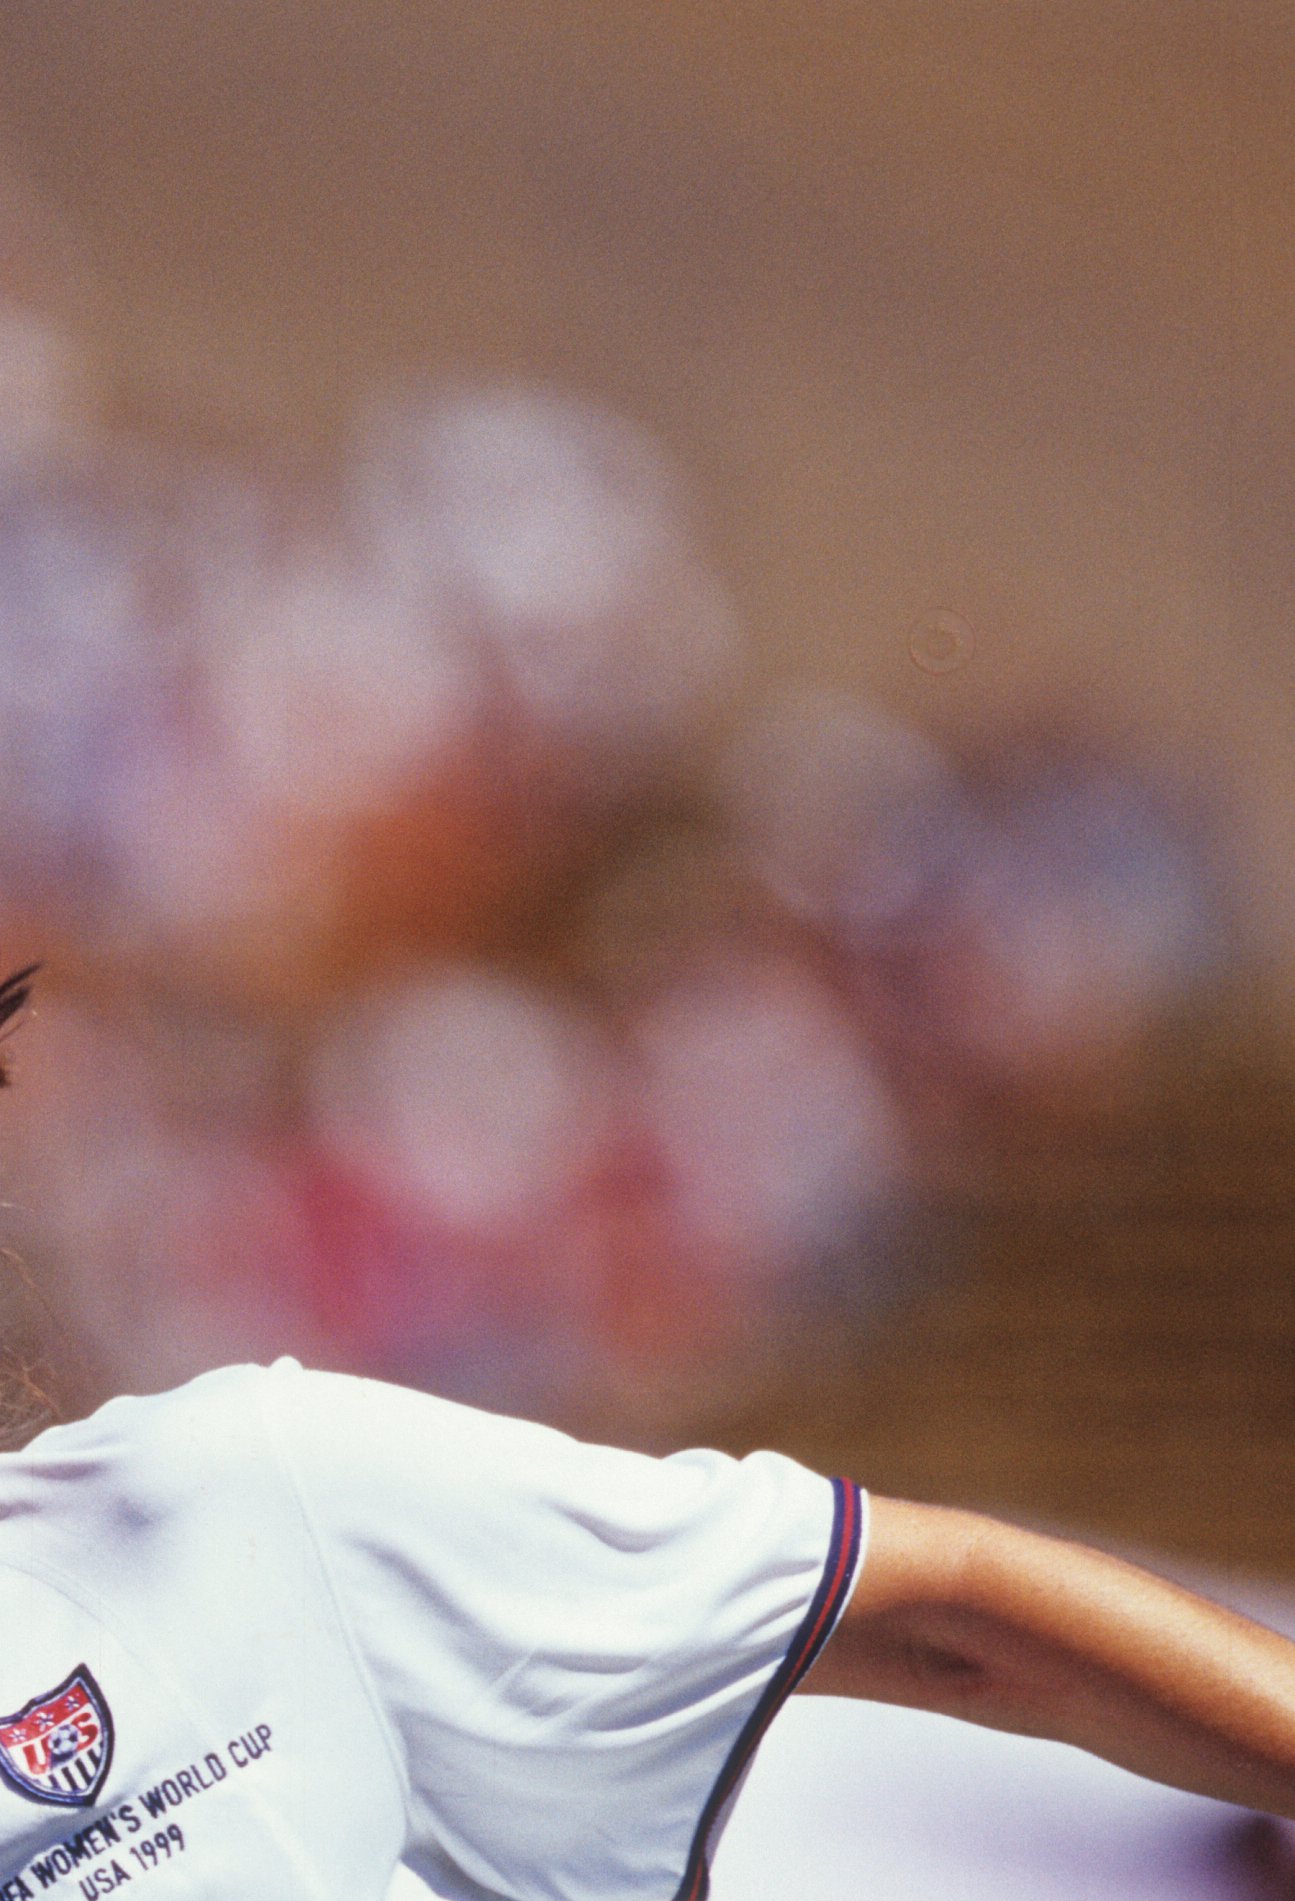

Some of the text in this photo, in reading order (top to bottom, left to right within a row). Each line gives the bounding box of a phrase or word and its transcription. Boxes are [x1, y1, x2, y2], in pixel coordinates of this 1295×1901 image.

[30, 1804, 142, 1889] WOMEN'S
[138, 1753, 227, 1819] WORLD
[227, 1724, 272, 1768] CUP
[129, 1823, 185, 1871] 1999
